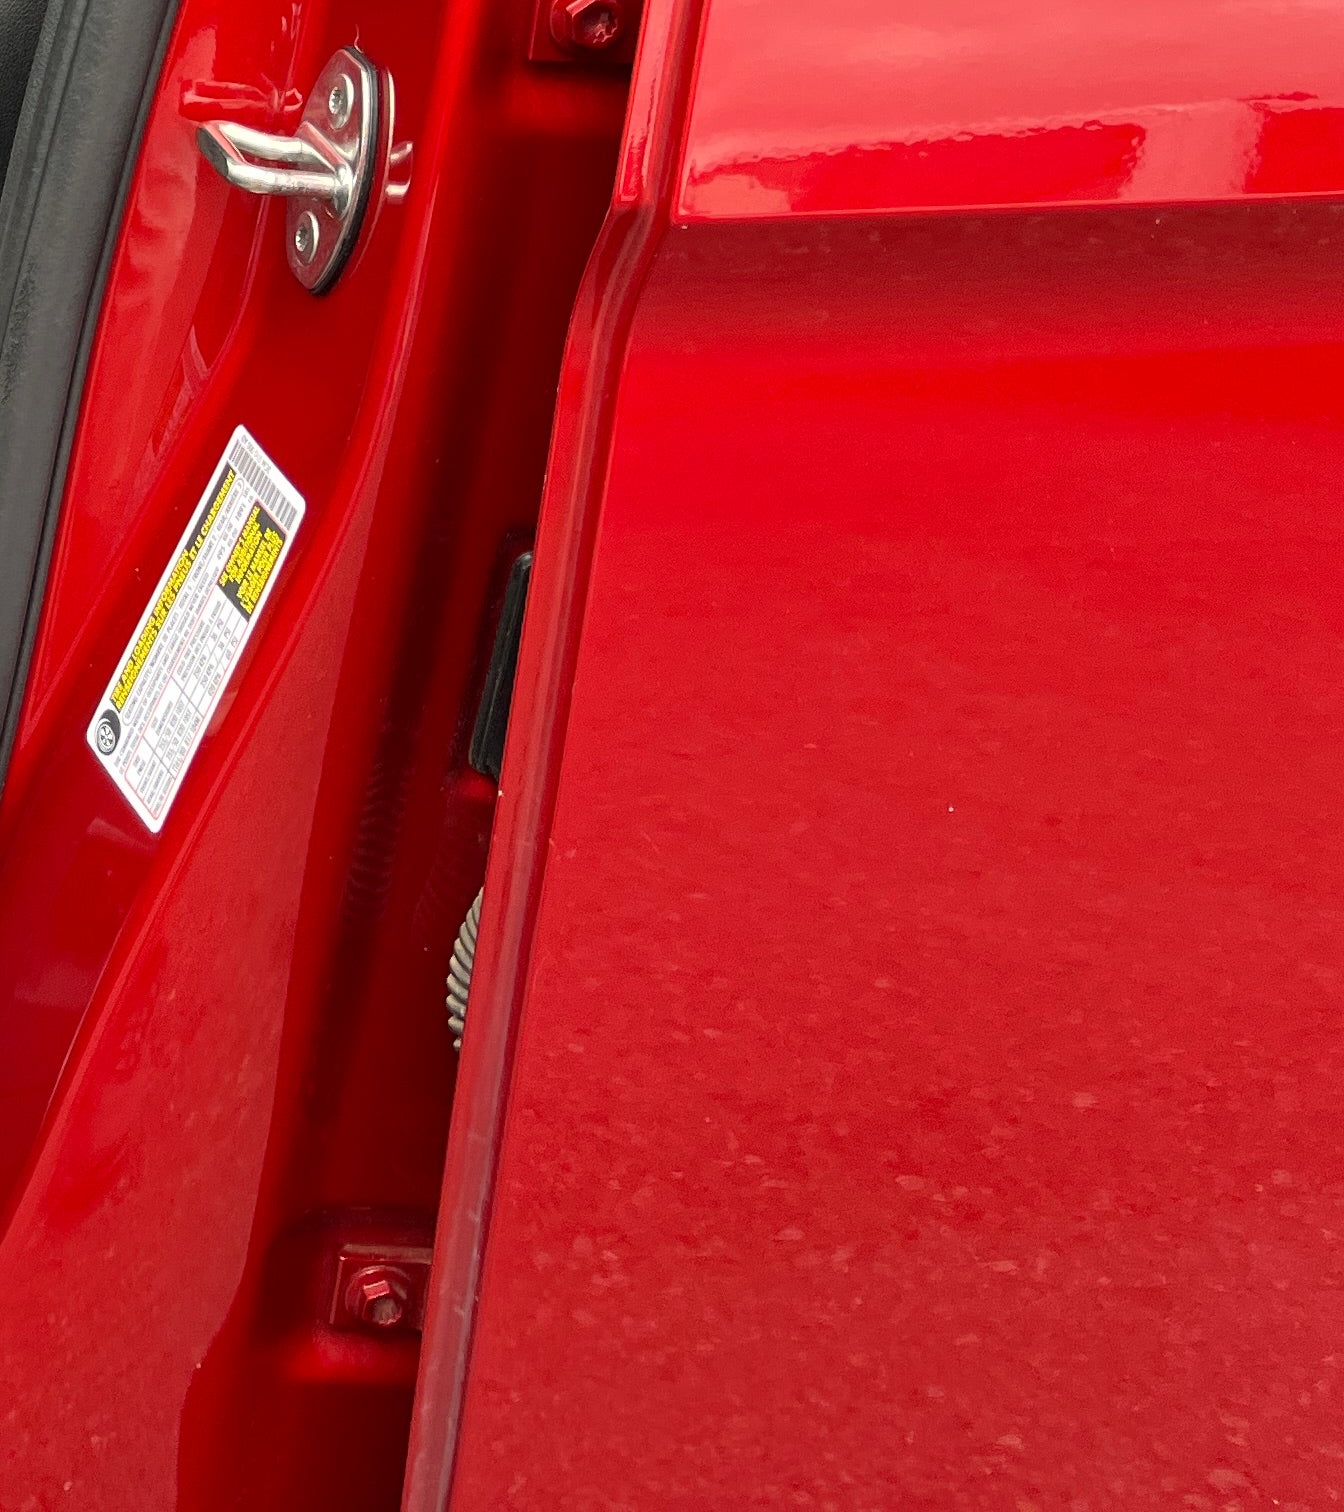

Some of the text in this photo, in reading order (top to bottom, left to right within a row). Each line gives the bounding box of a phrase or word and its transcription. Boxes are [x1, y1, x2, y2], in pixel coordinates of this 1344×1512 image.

[199, 468, 235, 538] CHARGEMENT
[120, 658, 134, 684] AND
[131, 614, 156, 662] LOADING
[152, 547, 188, 618] INFORMATION
